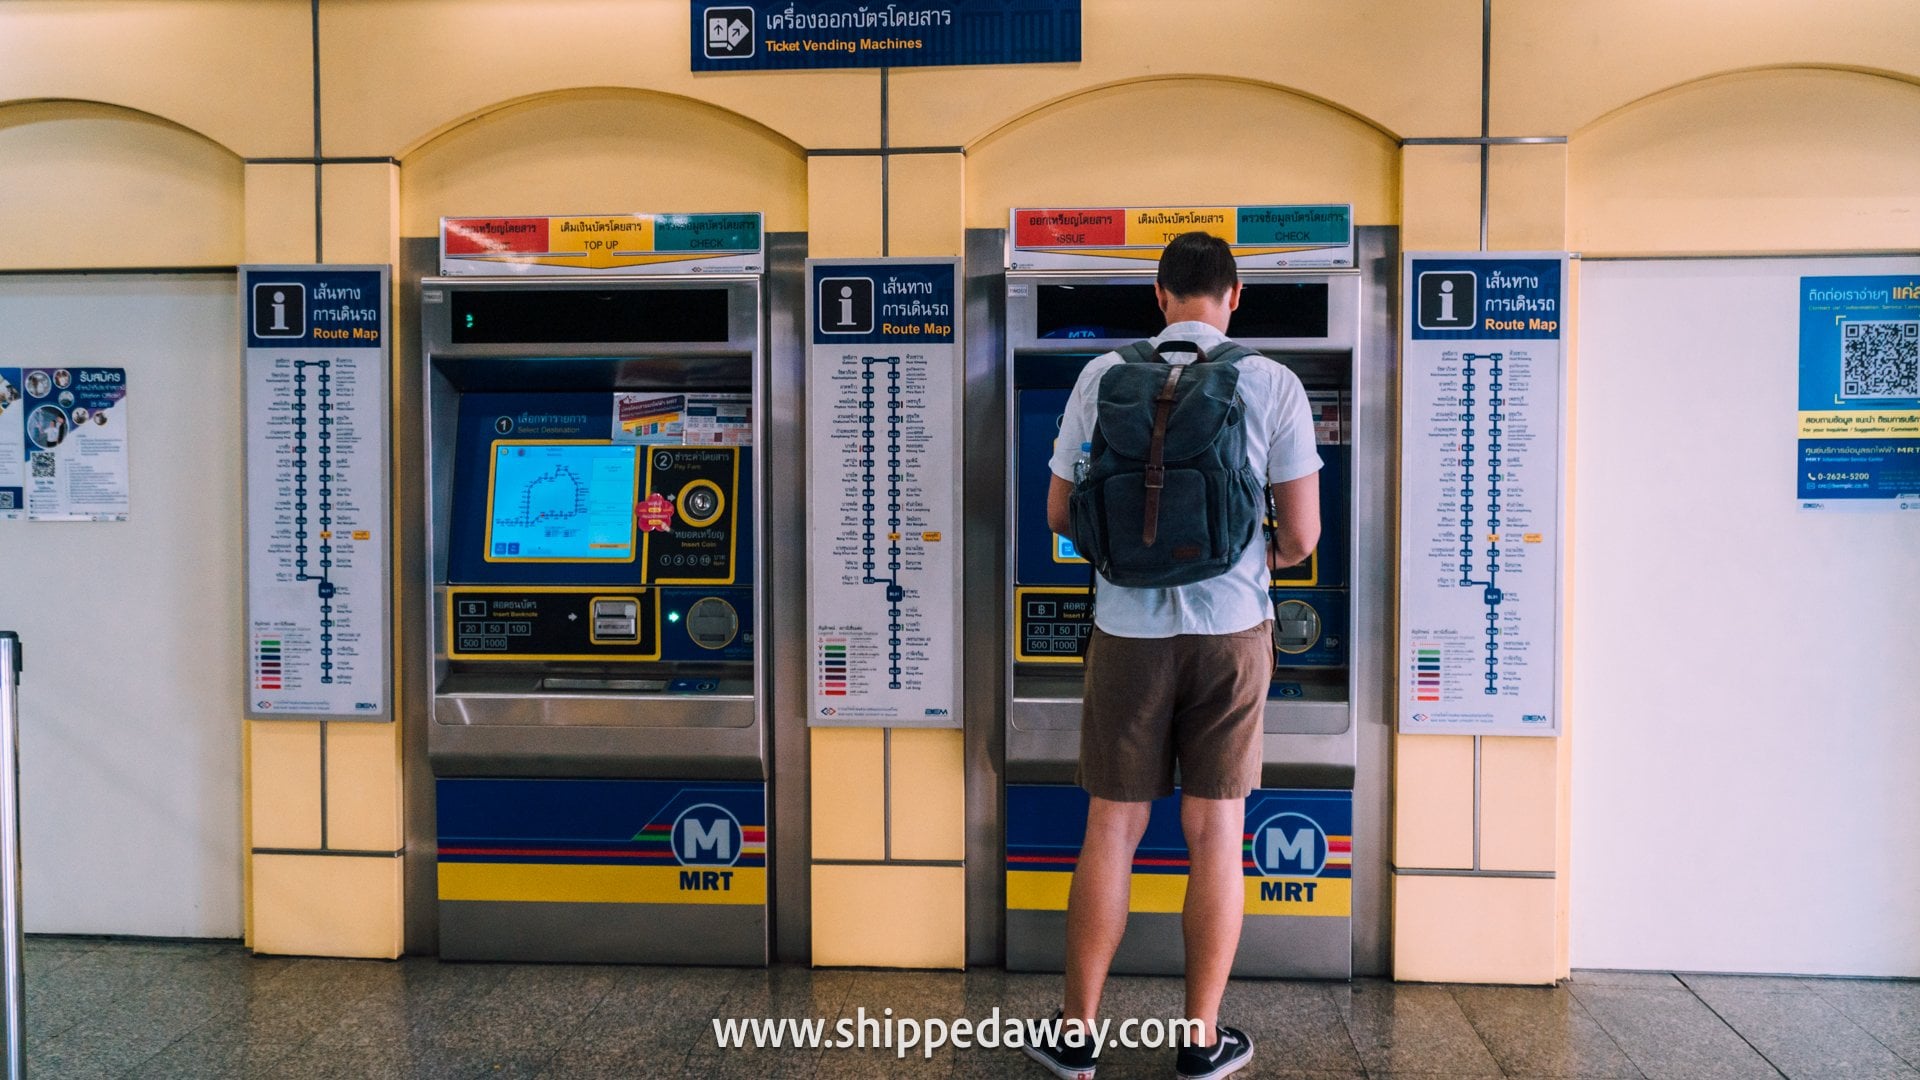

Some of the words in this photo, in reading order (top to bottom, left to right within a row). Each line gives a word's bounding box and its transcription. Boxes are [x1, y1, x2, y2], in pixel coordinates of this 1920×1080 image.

[766, 2, 951, 30] เครื่องออกบัตรโดยสาร
[765, 40, 800, 52] Ticket
[802, 39, 856, 53] Vending
[859, 38, 923, 50] Machines
[1275, 231, 1310, 241] CHECK
[584, 240, 603, 250] TOP
[605, 240, 619, 250] UP
[689, 239, 725, 248] CHECK
[882, 276, 933, 295] เส้นทาง
[1485, 270, 1539, 289] เส้นทาง
[313, 282, 361, 300] เส้นทาง
[882, 299, 949, 317] การเดินรถ
[1484, 294, 1555, 312] การเดินรถ
[313, 305, 376, 321] การเดินรถ
[882, 322, 921, 334] Route
[924, 322, 951, 336] Map
[1485, 318, 1525, 331] Route
[1528, 318, 1558, 332] Map
[313, 327, 349, 339] Route
[353, 327, 379, 341] Map
[500, 419, 507, 431] 1
[659, 455, 668, 467] 2
[1817, 472, 1870, 481] 0-2624-5200
[465, 624, 477, 633] 20
[489, 624, 501, 633] 50
[511, 624, 527, 633] 100
[1033, 626, 1045, 635] 20
[1059, 626, 1071, 635] 50
[463, 639, 479, 648] 500
[485, 638, 506, 648] 1000
[1031, 640, 1048, 650] 500
[1054, 640, 1076, 650] 1000
[683, 818, 731, 859] M
[1265, 827, 1315, 870] M
[679, 871, 734, 891] MRT
[1260, 881, 1318, 902] MRT
